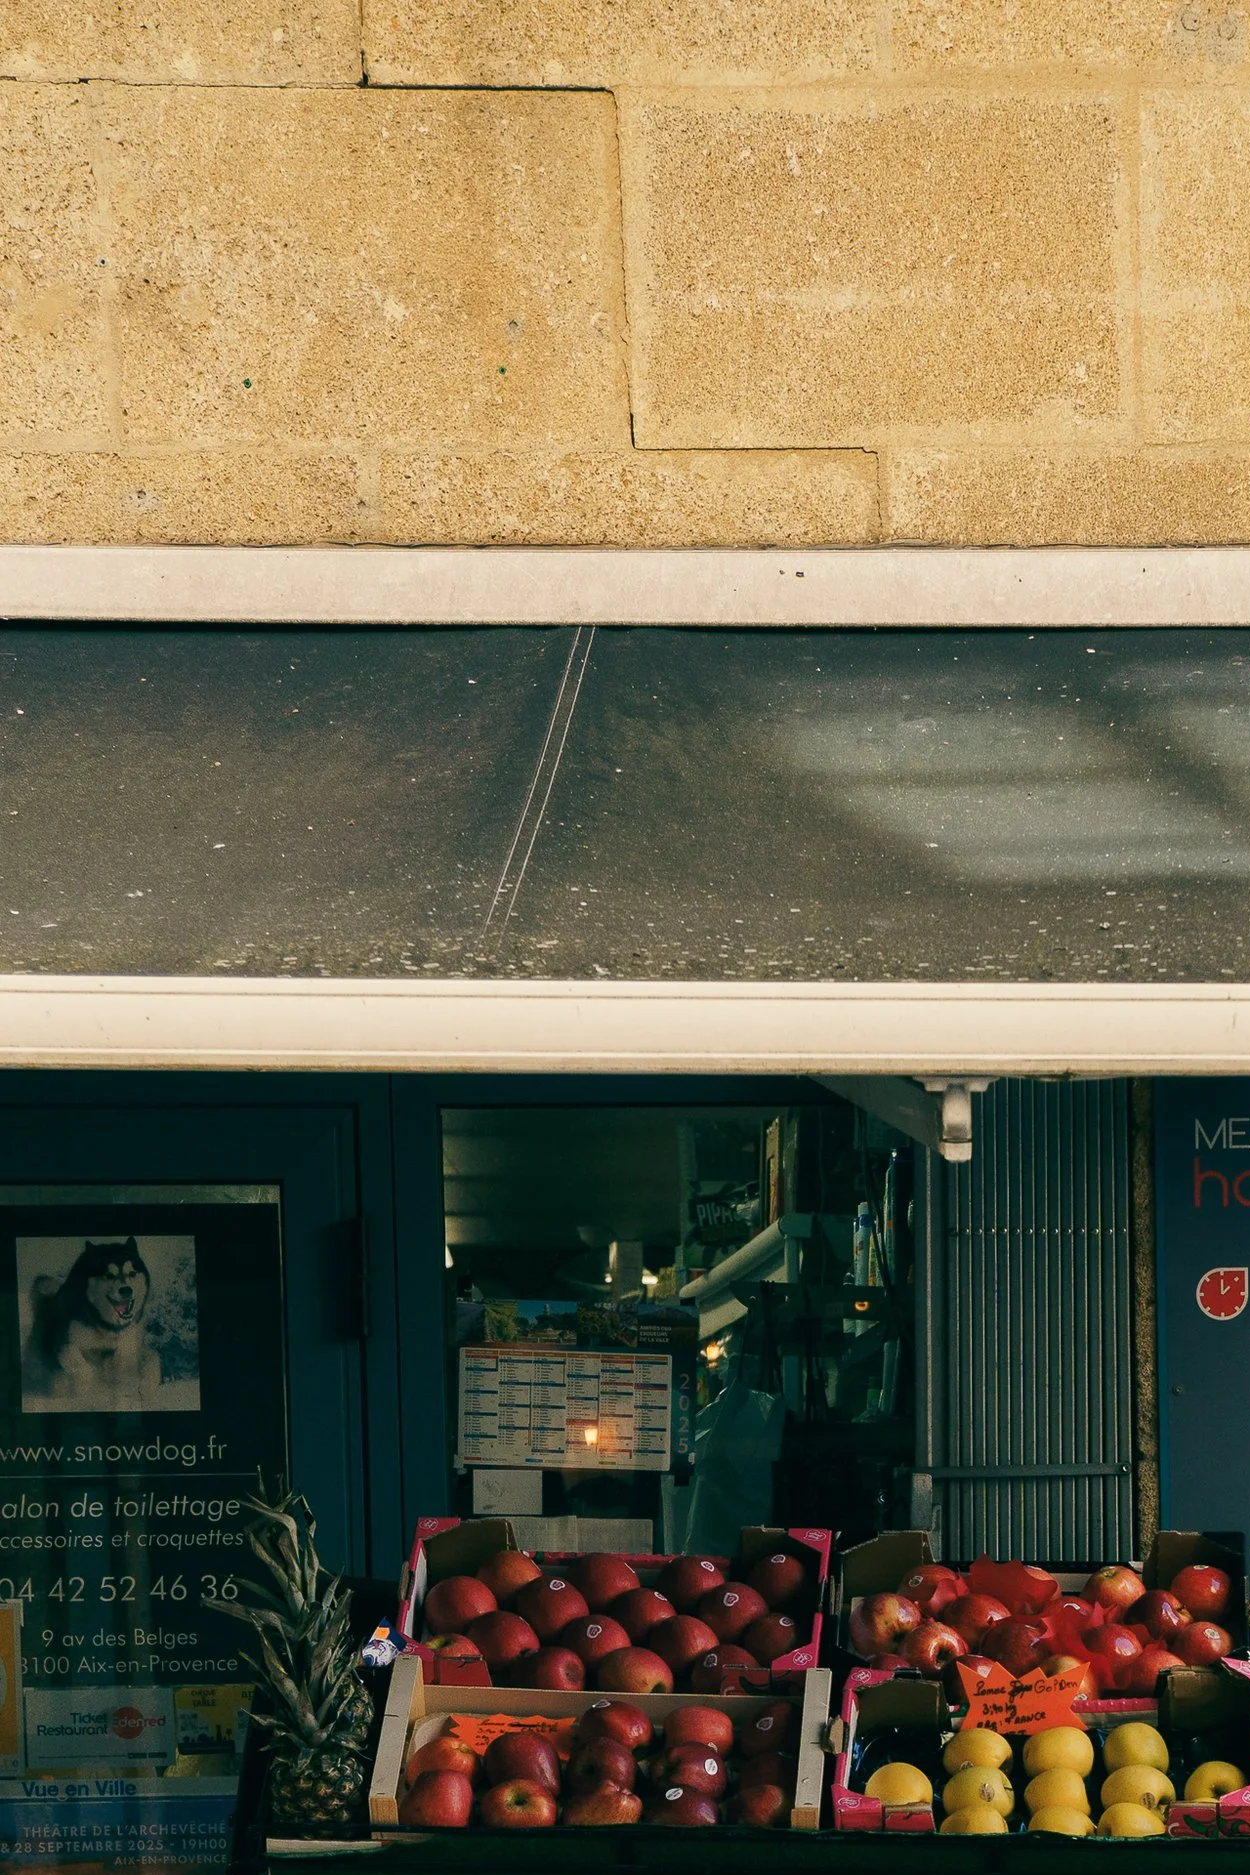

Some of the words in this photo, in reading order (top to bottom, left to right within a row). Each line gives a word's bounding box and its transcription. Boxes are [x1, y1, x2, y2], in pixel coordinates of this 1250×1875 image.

[0, 1435, 228, 1467] www.snowdog.fr
[1, 1493, 60, 1519] alon
[70, 1492, 104, 1518] de
[114, 1491, 241, 1522] toilettage
[0, 1529, 104, 1549] ccessoires
[111, 1529, 131, 1547] et
[137, 1528, 244, 1551] croquettes
[0, 1577, 36, 1603] 04
[48, 1576, 85, 1603] 42
[99, 1575, 137, 1602] 52
[149, 1574, 188, 1601] 46
[200, 1573, 239, 1600] 36
[42, 1629, 55, 1649] 9
[62, 1632, 85, 1648] av
[92, 1627, 127, 1648] des
[134, 1627, 199, 1651] Belges
[21, 1656, 70, 1675] 3100
[77, 1655, 239, 1674] Aix-en-Provence
[70, 1712, 109, 1725] Ticket
[113, 1714, 167, 1729] Edenred
[37, 1724, 108, 1737] Restaurant
[22, 1782, 59, 1797] Vue
[65, 1783, 89, 1796] en
[95, 1780, 137, 1797] Ville
[23, 1823, 87, 1838] THÉÂTRE
[92, 1824, 111, 1837] DE
[13, 1842, 32, 1854] 28
[38, 1840, 122, 1853] SEPTEMBRE
[127, 1839, 164, 1851] 2025
[181, 1838, 228, 1850] 19H00
[114, 1854, 228, 1866] AIX-EN-PROVENCE
